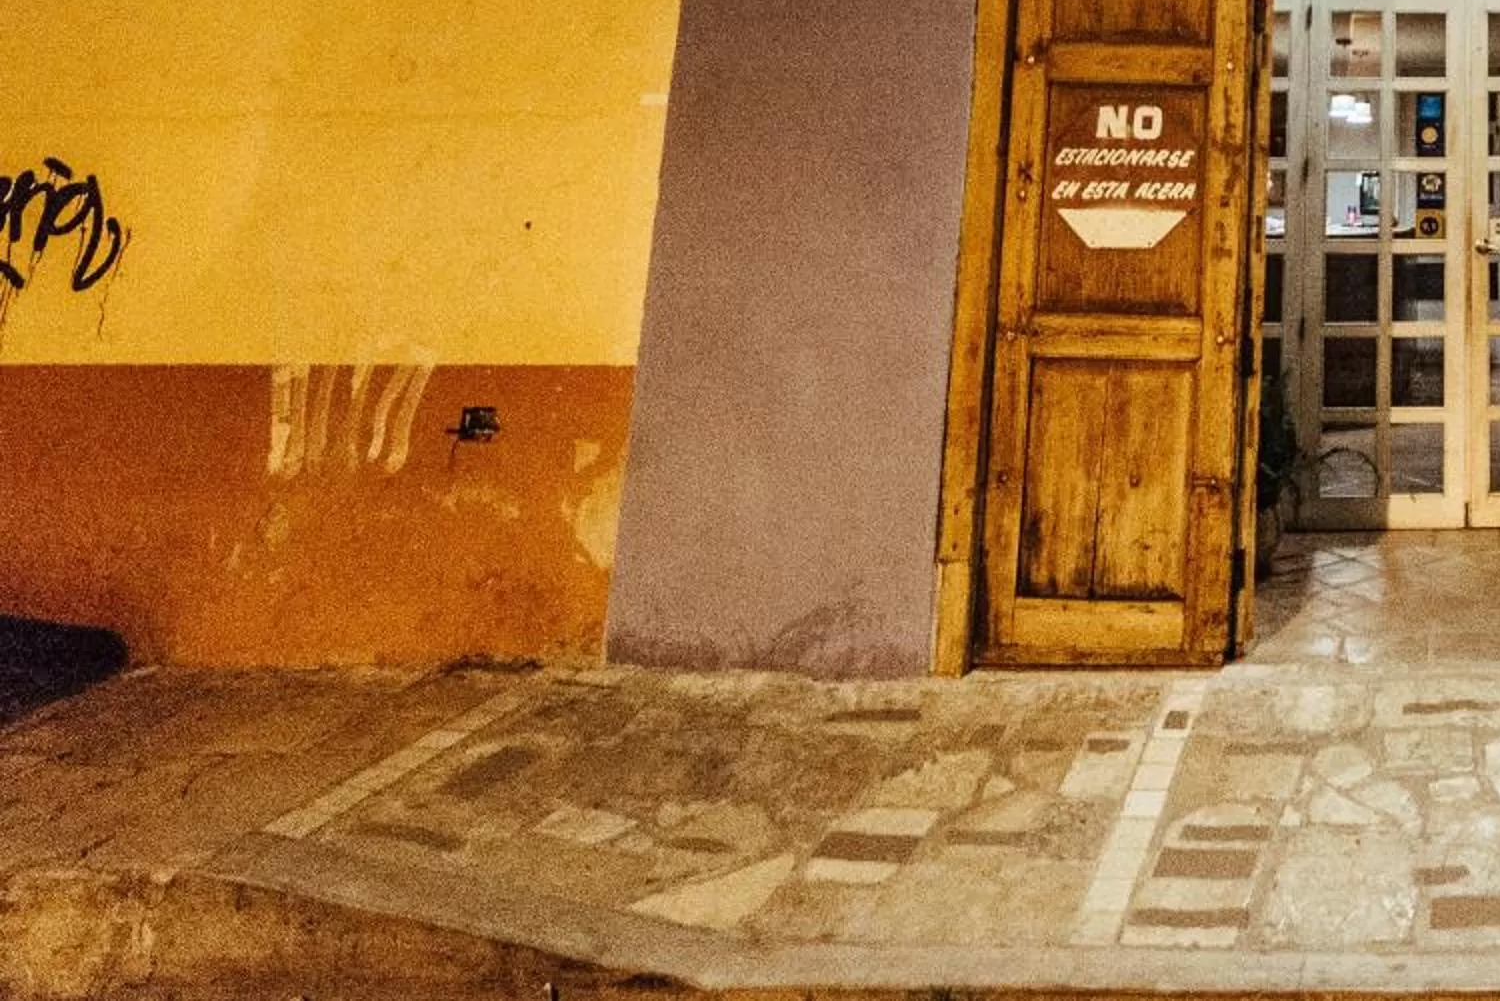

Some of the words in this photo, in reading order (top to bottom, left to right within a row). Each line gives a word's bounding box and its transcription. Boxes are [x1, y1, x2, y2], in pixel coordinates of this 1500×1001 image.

[1096, 106, 1163, 140] NO
[1055, 148, 1195, 168] ESTACIONARSE
[1052, 181, 1081, 200] EN
[1082, 181, 1129, 200] ESTA
[1134, 181, 1197, 200] ACERA
